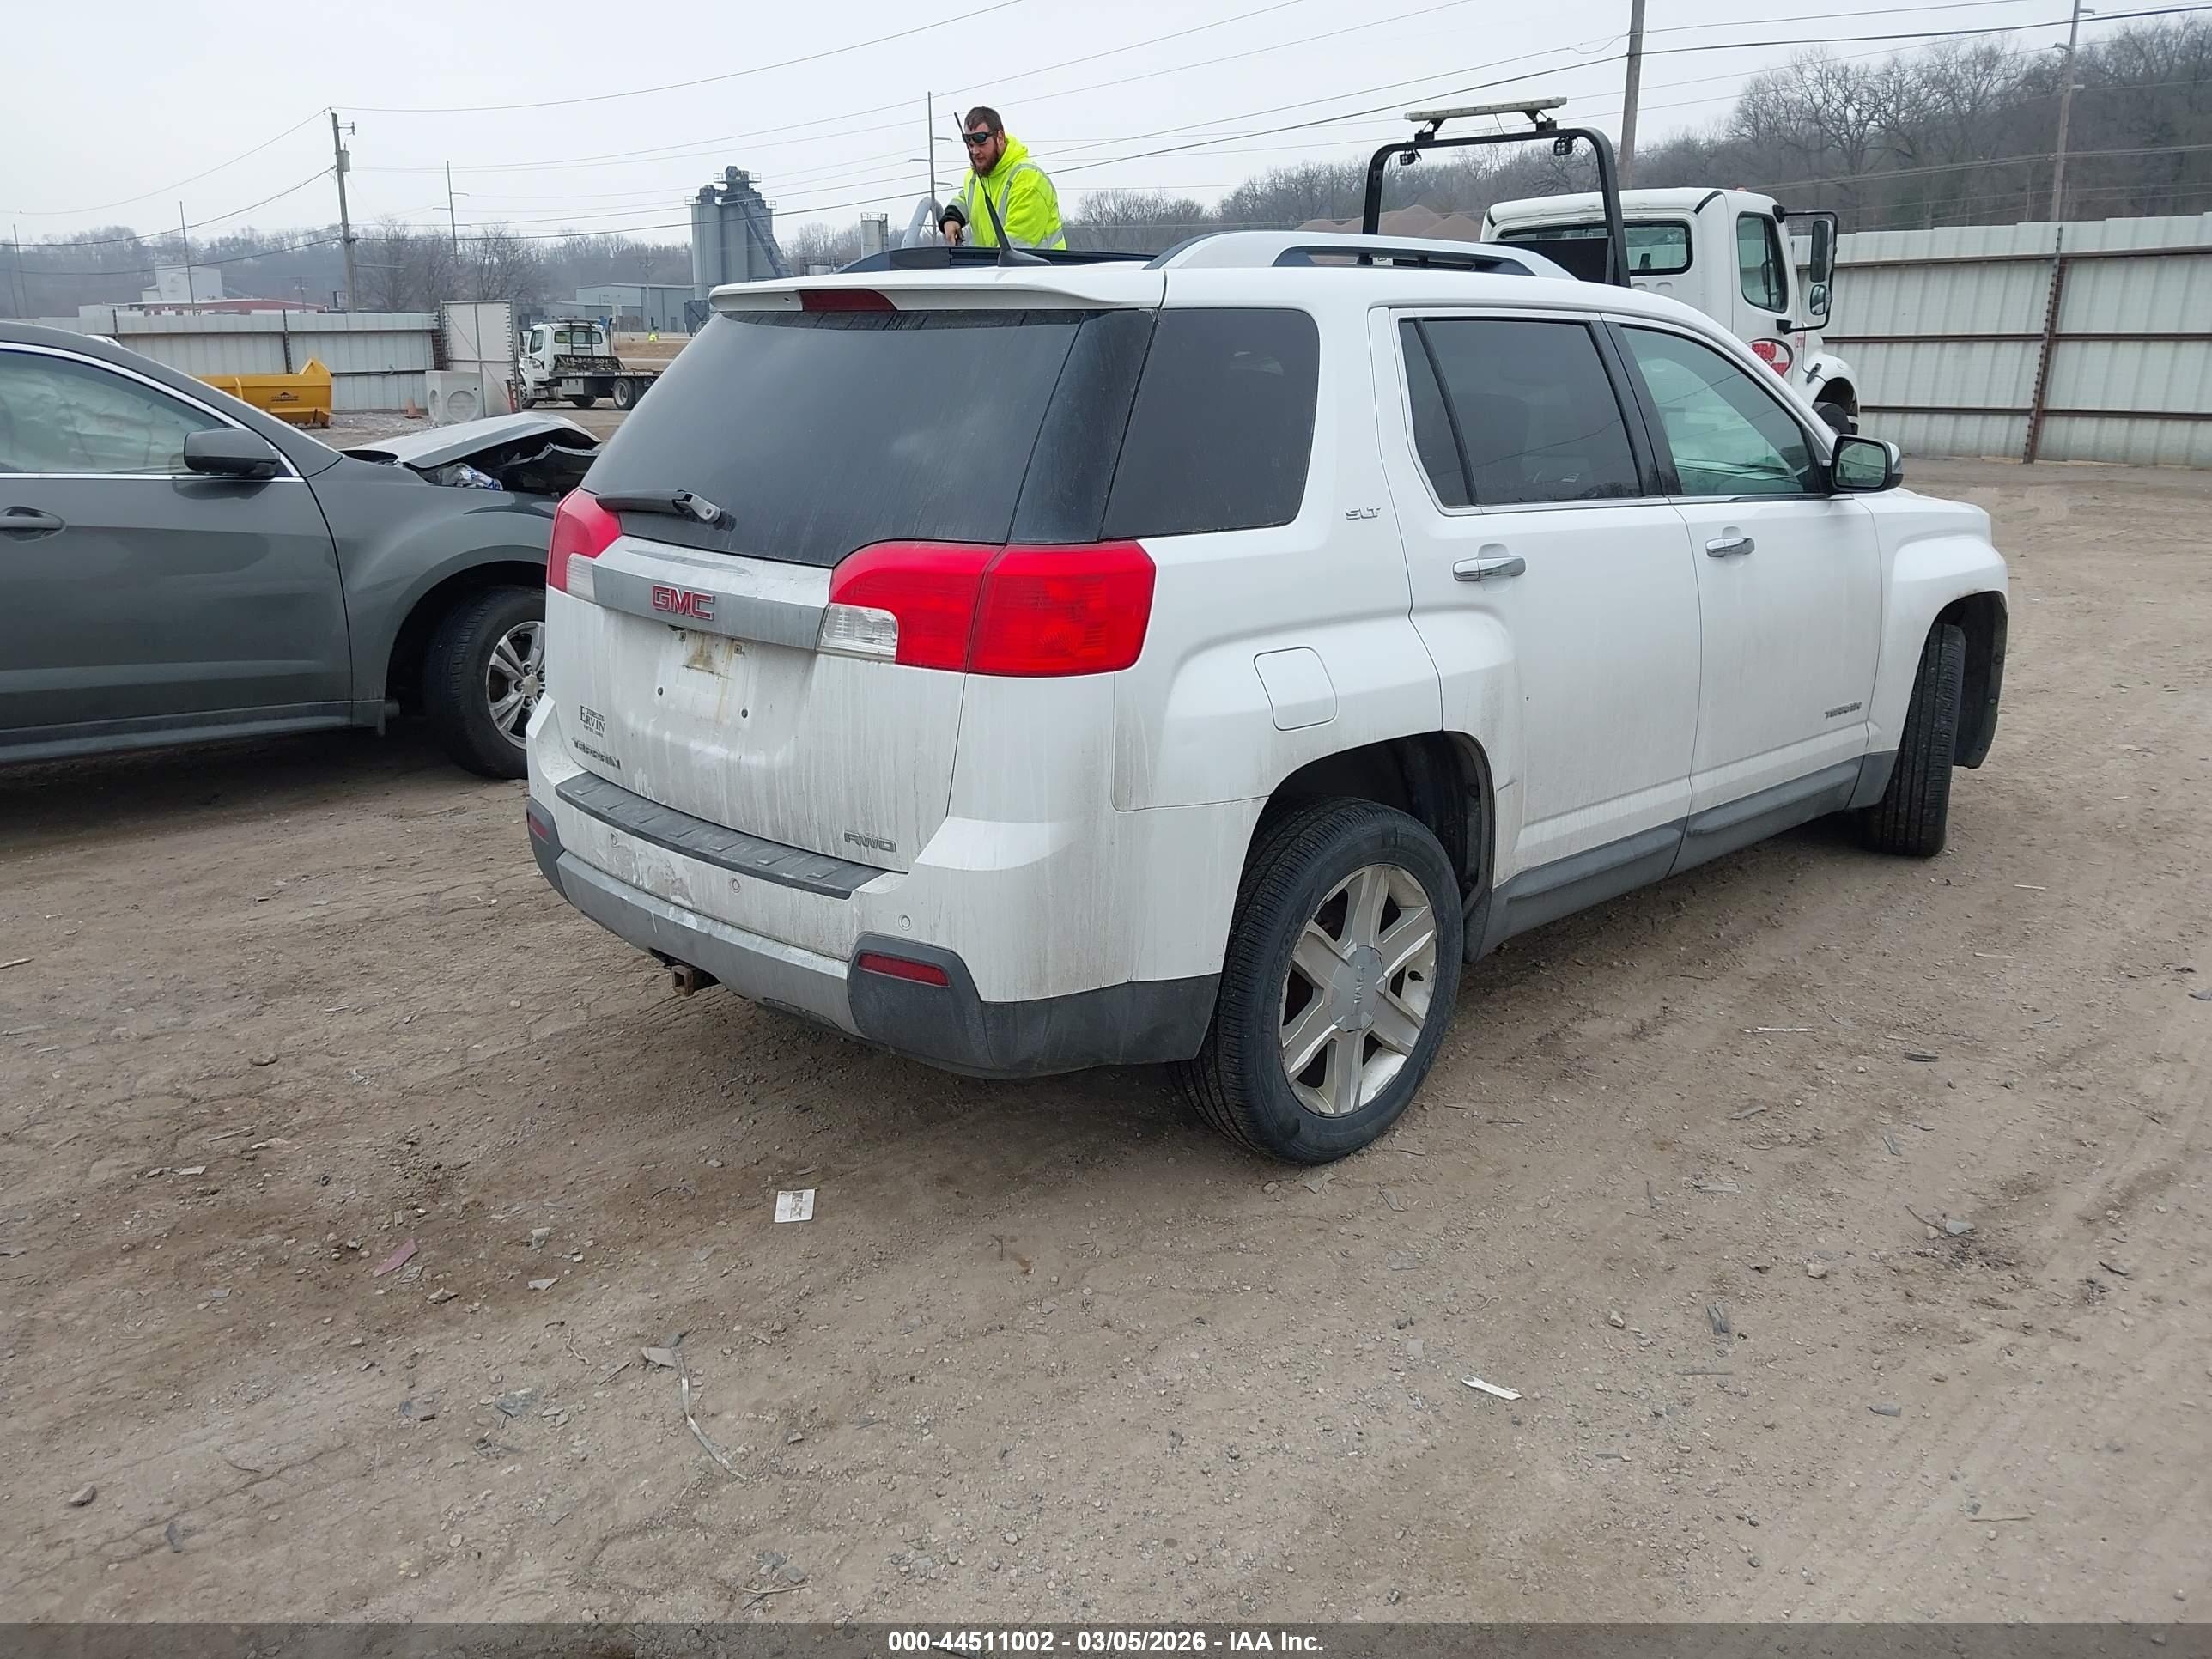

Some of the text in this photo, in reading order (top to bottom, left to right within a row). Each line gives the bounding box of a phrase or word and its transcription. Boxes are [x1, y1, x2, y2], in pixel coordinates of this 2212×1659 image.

[1345, 507, 1382, 520] SLT
[652, 584, 716, 622] GMC
[579, 704, 605, 734] ERVIN
